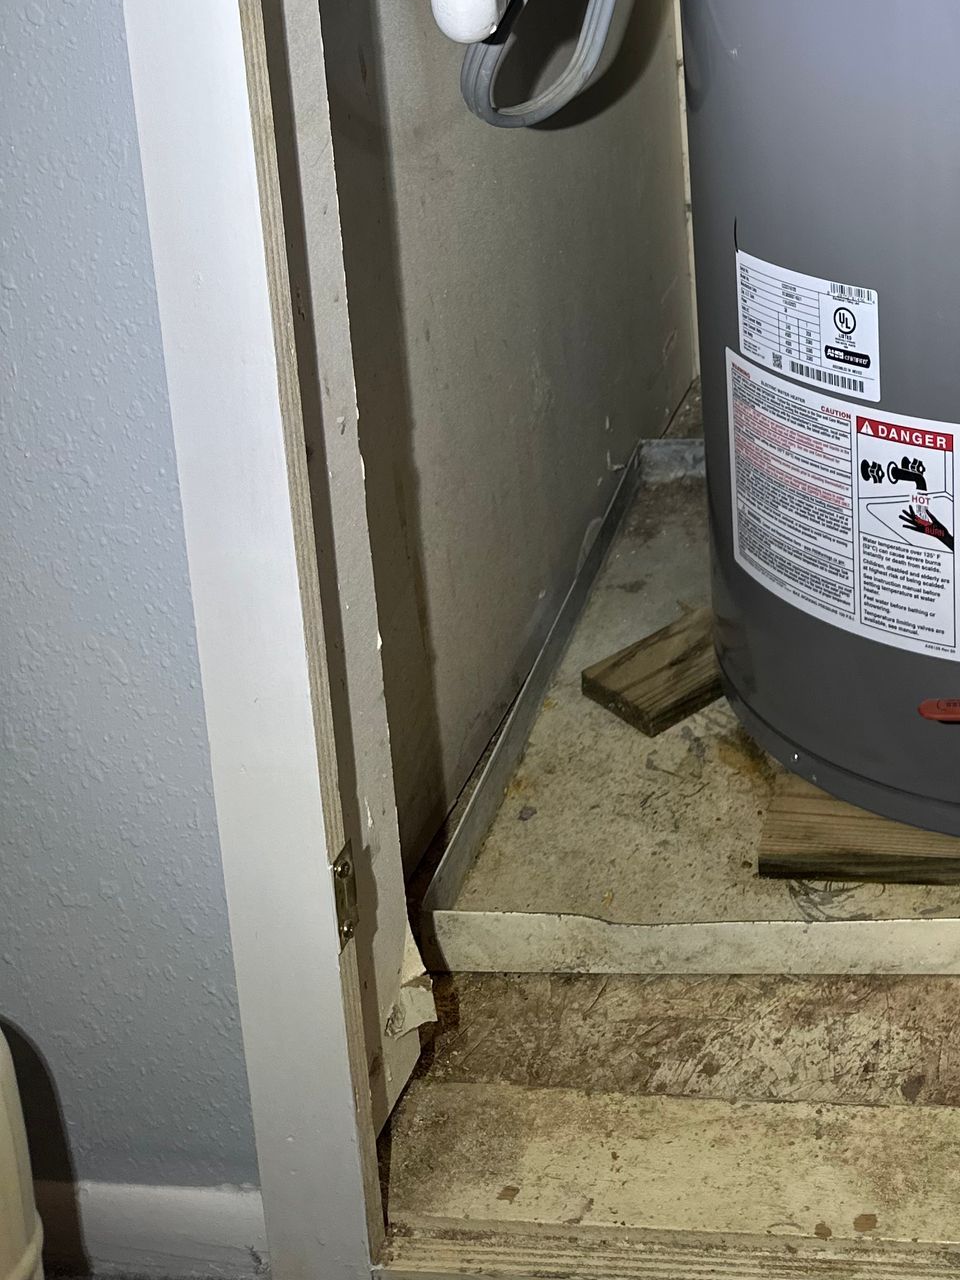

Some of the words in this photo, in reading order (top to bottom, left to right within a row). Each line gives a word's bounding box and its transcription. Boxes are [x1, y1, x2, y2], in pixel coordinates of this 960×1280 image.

[778, 387, 789, 396] WATER
[790, 392, 805, 403] HEATER
[820, 405, 851, 419] CAUTION
[878, 425, 946, 448] DANGER
[912, 495, 930, 505] HOT
[925, 526, 944, 537] BURN
[863, 536, 876, 544] Water
[878, 538, 909, 553] temperature
[863, 558, 885, 568] Children,
[886, 565, 908, 575] disabled
[921, 573, 939, 583] elderly
[892, 557, 906, 566] death
[922, 564, 941, 573] scalds.
[925, 557, 941, 566] burns
[869, 565, 887, 576] highest
[889, 571, 898, 579] risk
[906, 576, 921, 586] being
[923, 580, 945, 590] scalded.
[874, 576, 900, 588] instruction
[902, 584, 922, 593] manual
[923, 589, 940, 597] before
[864, 580, 880, 590] setting
[881, 585, 912, 598] temperature
[920, 595, 935, 603] water
[864, 602, 890, 614] showering.
[875, 598, 889, 606] water
[890, 601, 907, 610] before
[908, 607, 928, 617] bathing
[864, 609, 895, 623] Temperature
[896, 619, 916, 629] limiting
[917, 624, 934, 633] valves
[864, 616, 887, 626] available,
[898, 626, 919, 635] manual.
